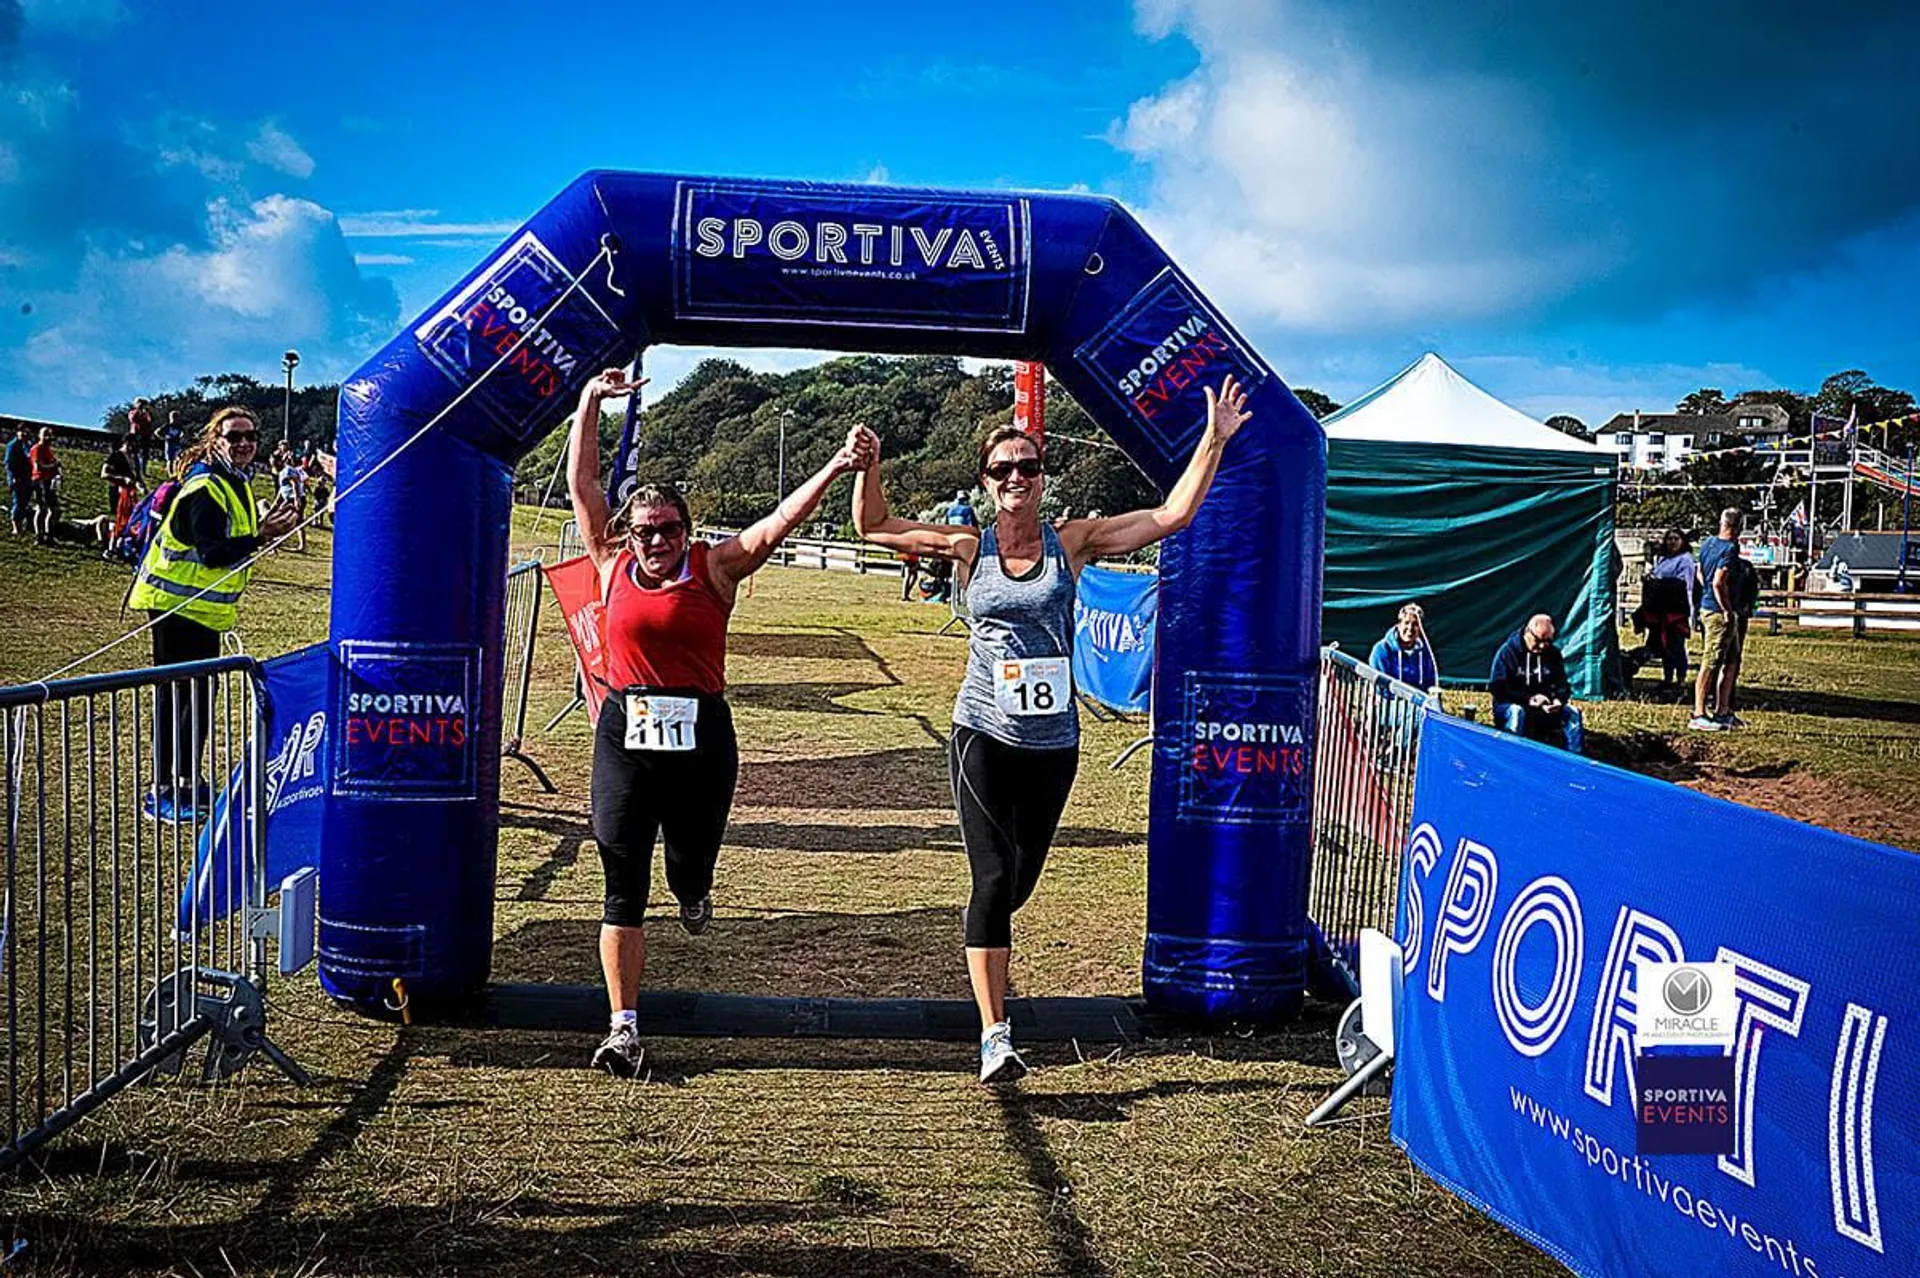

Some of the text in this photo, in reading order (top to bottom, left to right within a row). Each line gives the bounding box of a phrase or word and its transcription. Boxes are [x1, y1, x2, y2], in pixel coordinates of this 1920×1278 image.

[696, 217, 985, 268] SPORTIVA
[979, 230, 1005, 271] EVENTS
[464, 302, 555, 397] EVENTS
[1118, 315, 1208, 396] SPORTIVA
[1133, 332, 1229, 419] EVENTS
[348, 692, 465, 714] SPORTIVA
[1013, 682, 1055, 711] 18
[347, 717, 465, 745] EVENTS
[635, 718, 683, 746] 111
[1195, 721, 1304, 744] SPORTIVA
[1193, 743, 1304, 775] EVENTS
